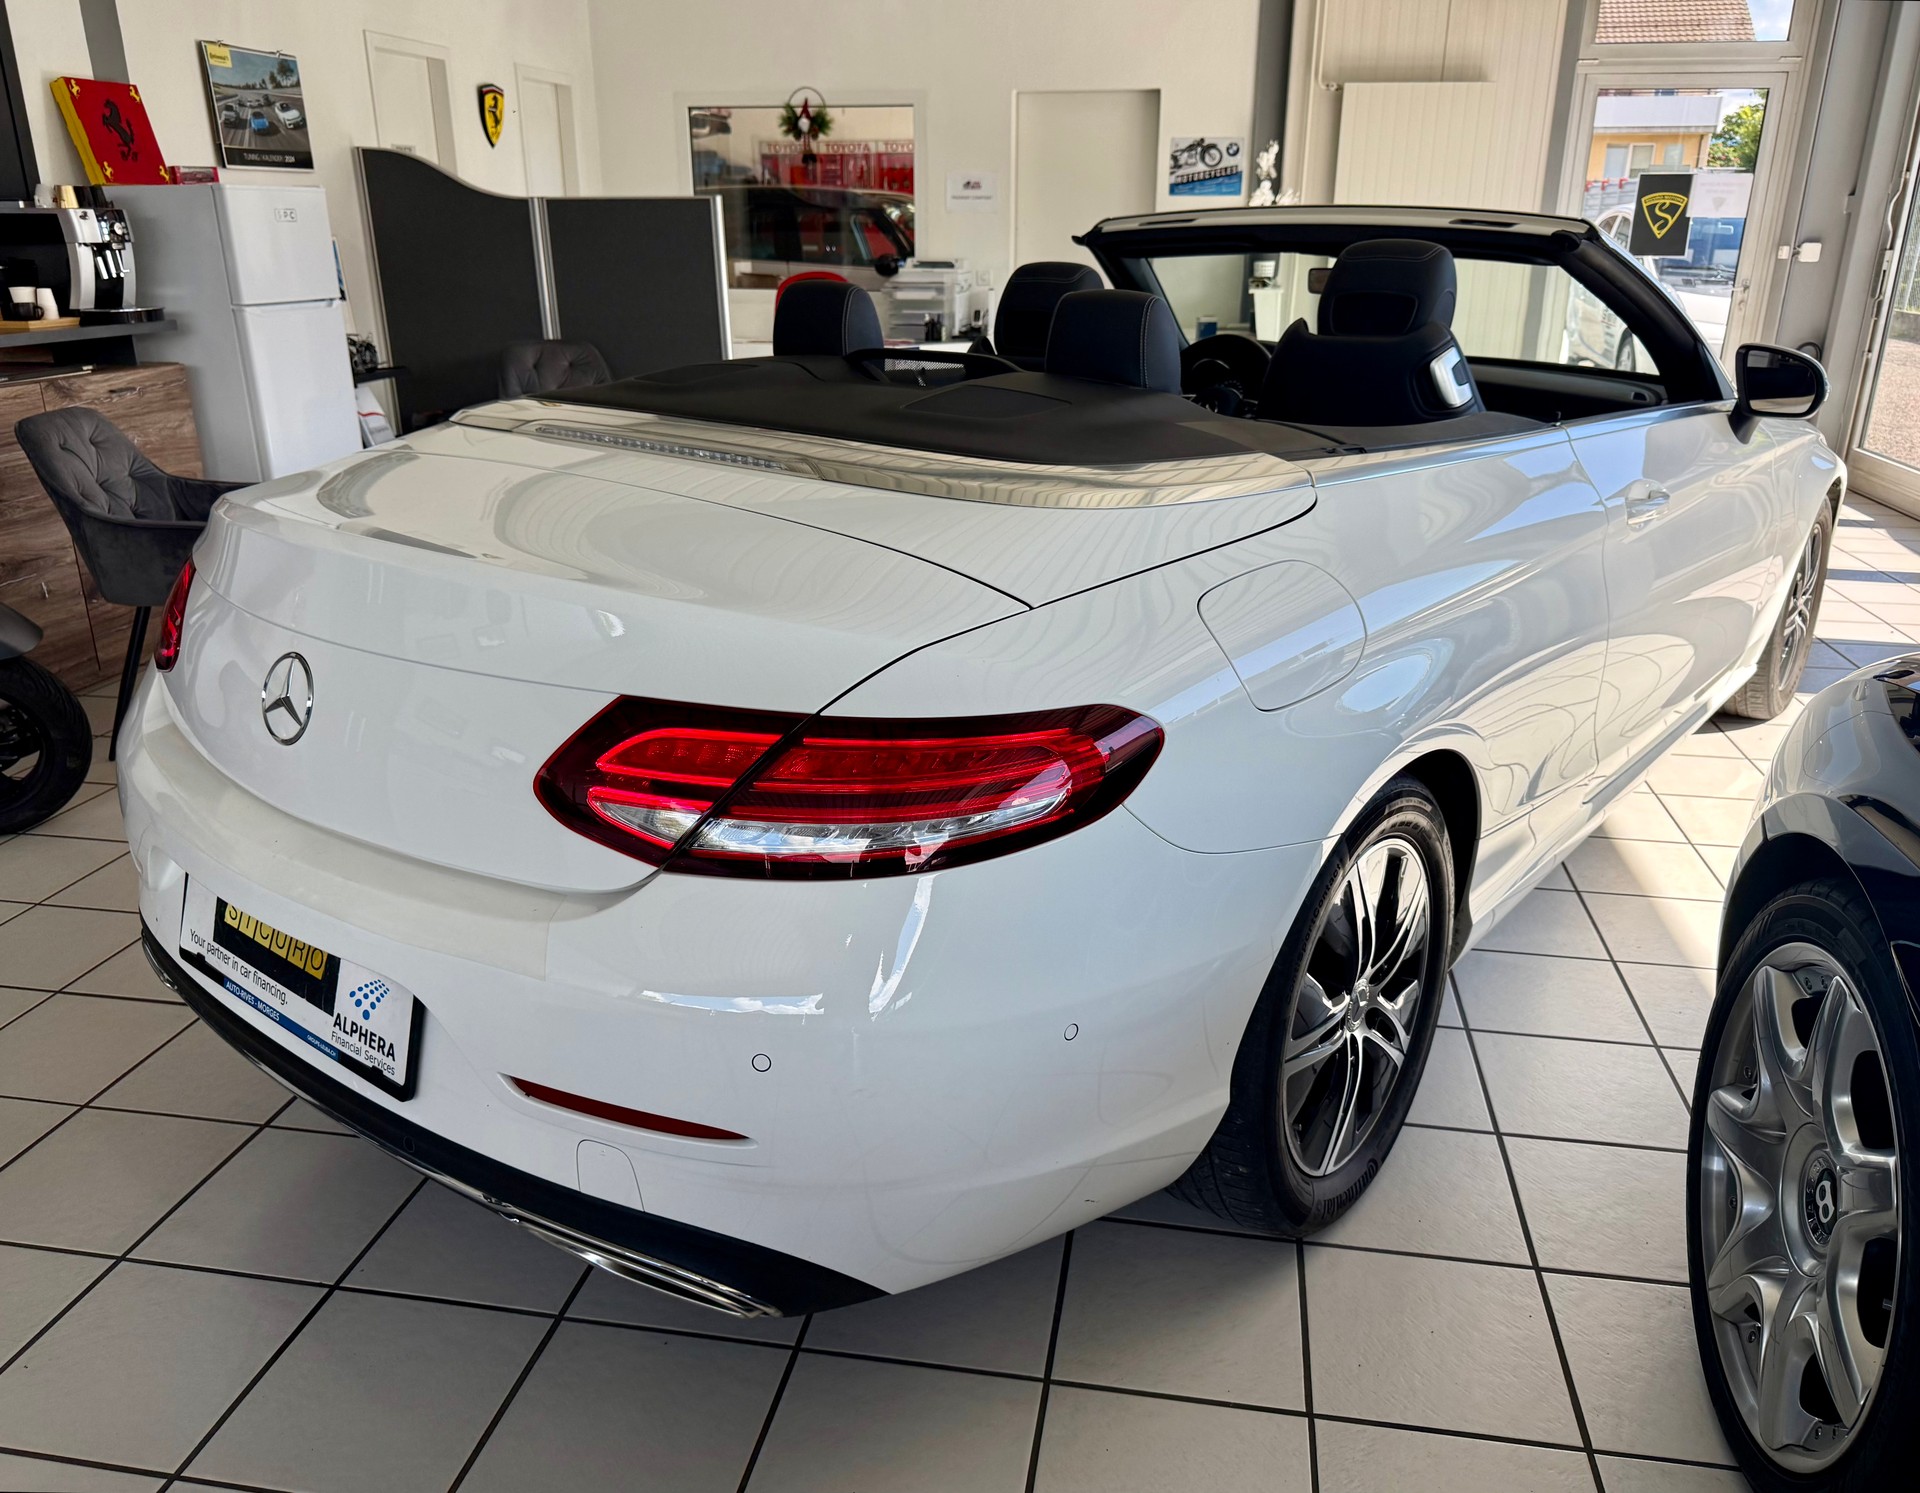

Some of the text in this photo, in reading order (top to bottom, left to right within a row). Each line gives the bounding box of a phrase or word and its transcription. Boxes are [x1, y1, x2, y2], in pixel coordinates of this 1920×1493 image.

[825, 143, 870, 154] TOYOTA
[1175, 165, 1239, 184] MOTORCYCLES
[190, 928, 288, 1005] Your partner in car financing.
[226, 980, 255, 1006] AUTO-RIVES
[257, 1001, 280, 1022] MORGES
[331, 1030, 396, 1076] Financial Services
[333, 1012, 396, 1063] ALPHERA
[1321, 1158, 1379, 1220] Continental
